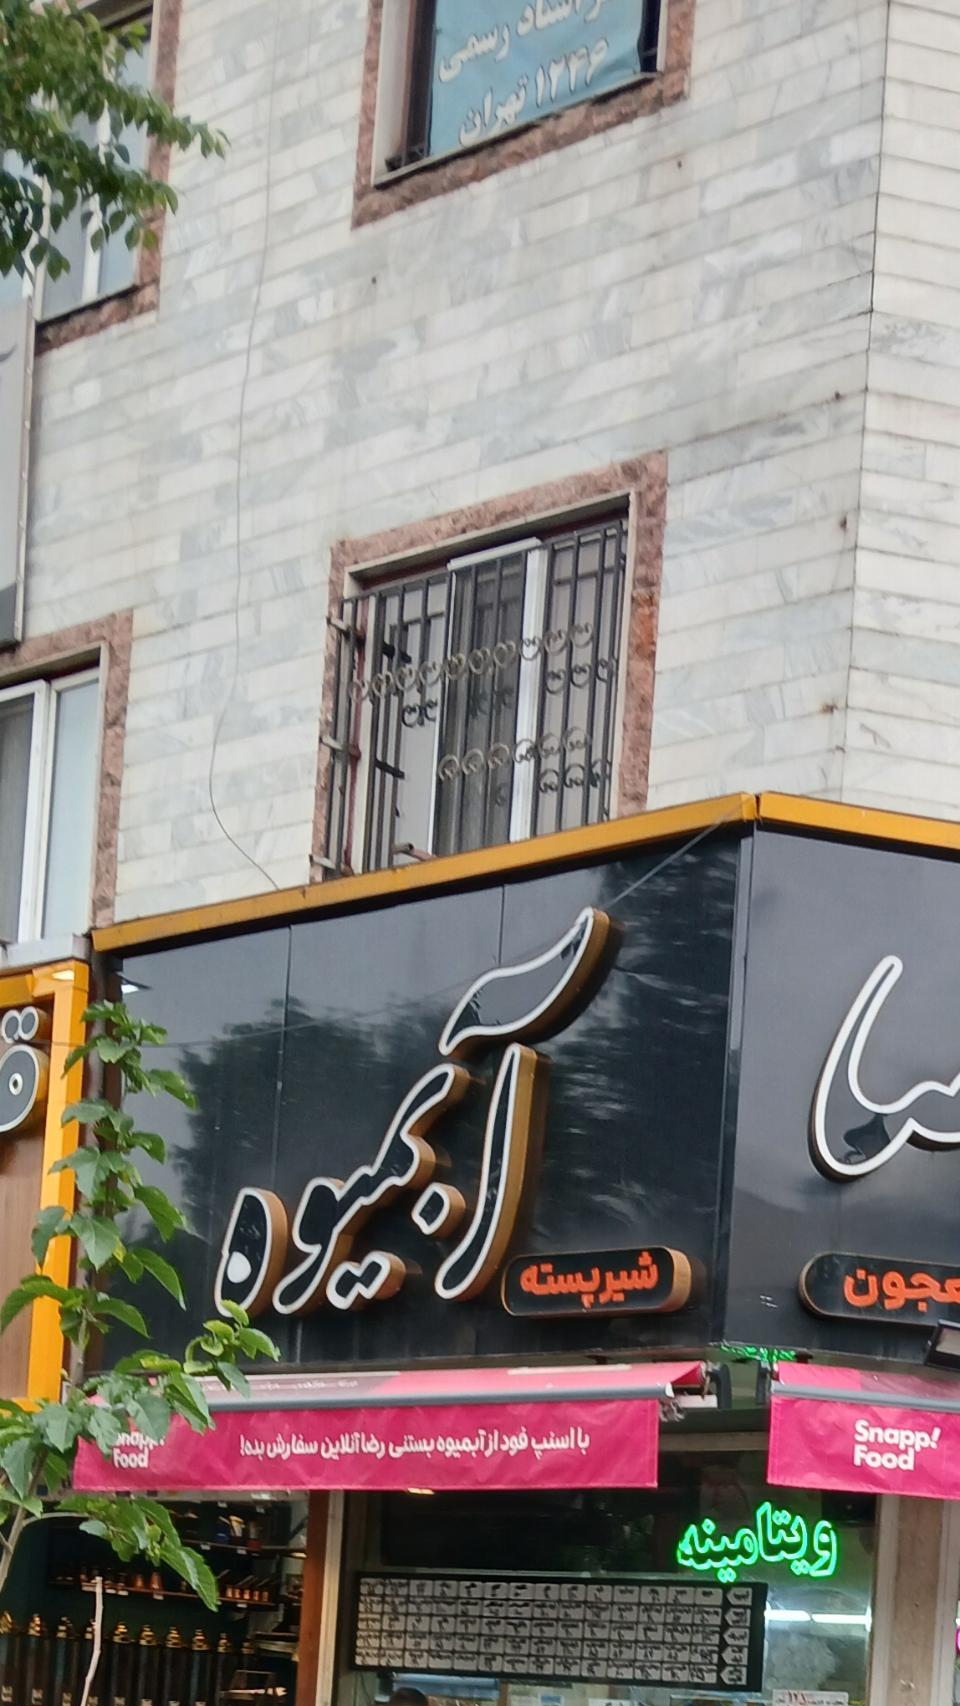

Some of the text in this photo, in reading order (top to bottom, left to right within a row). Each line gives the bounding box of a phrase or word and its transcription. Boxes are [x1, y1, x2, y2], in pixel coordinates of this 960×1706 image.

[439, 24, 510, 82] رسمی
[459, 74, 529, 147] تهران
[239, 1433, 265, 1461] بده!
[266, 1432, 319, 1461] سفارش
[320, 1431, 360, 1461] آنلاین
[361, 1432, 386, 1460] رضا
[388, 1433, 435, 1459] بستنی
[436, 1428, 486, 1459] آبمیوه
[484, 1428, 500, 1458] از
[500, 1425, 529, 1457] فود
[530, 1426, 575, 1461] اسنپ
[853, 1419, 941, 1451] Snapp!
[112, 1447, 149, 1469] Food
[853, 1444, 915, 1472] Food
[676, 1500, 839, 1583] ویتامینه
